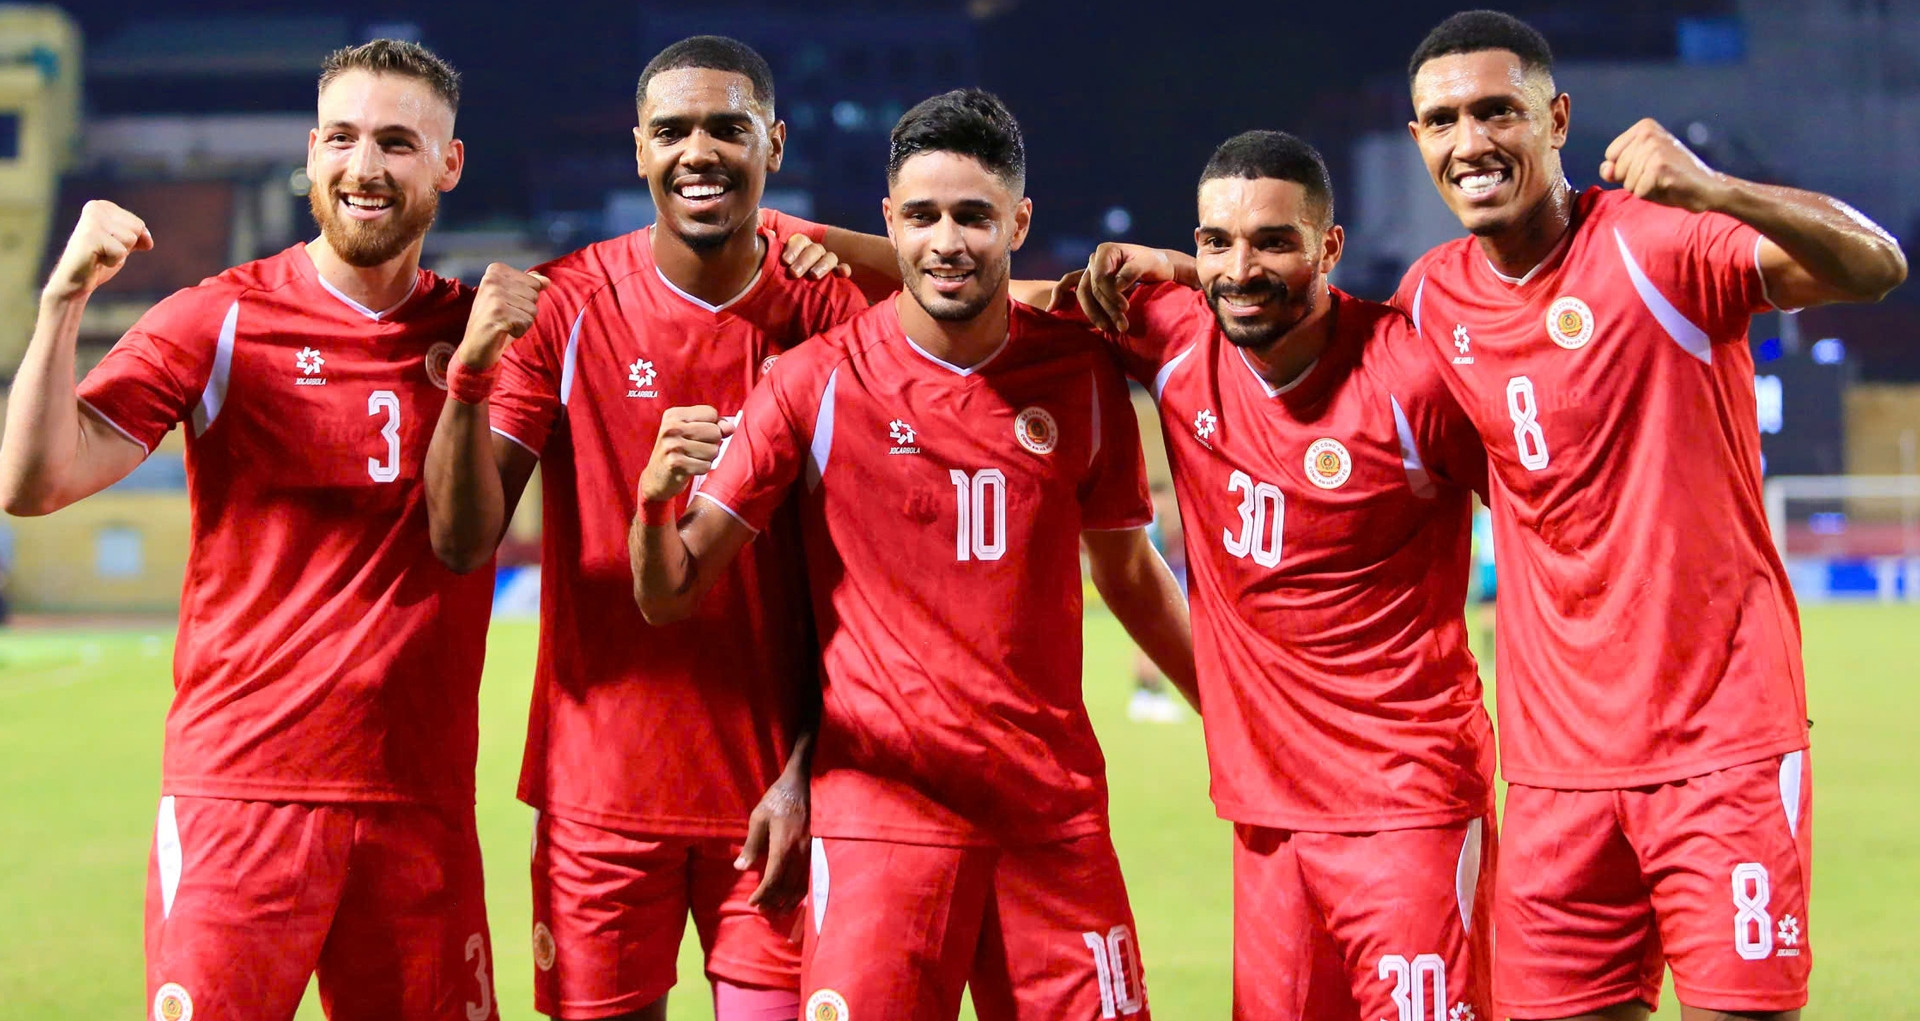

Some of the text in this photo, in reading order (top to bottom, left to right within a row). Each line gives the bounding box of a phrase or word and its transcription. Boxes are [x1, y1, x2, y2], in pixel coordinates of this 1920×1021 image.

[367, 390, 400, 482] 3
[1506, 375, 1549, 471] 8
[949, 468, 1006, 561] 10
[1223, 469, 1285, 569] 30
[1731, 862, 1773, 960] 8
[465, 932, 491, 1021] 3
[1082, 925, 1143, 1019] 10
[1378, 953, 1447, 1021] 30
